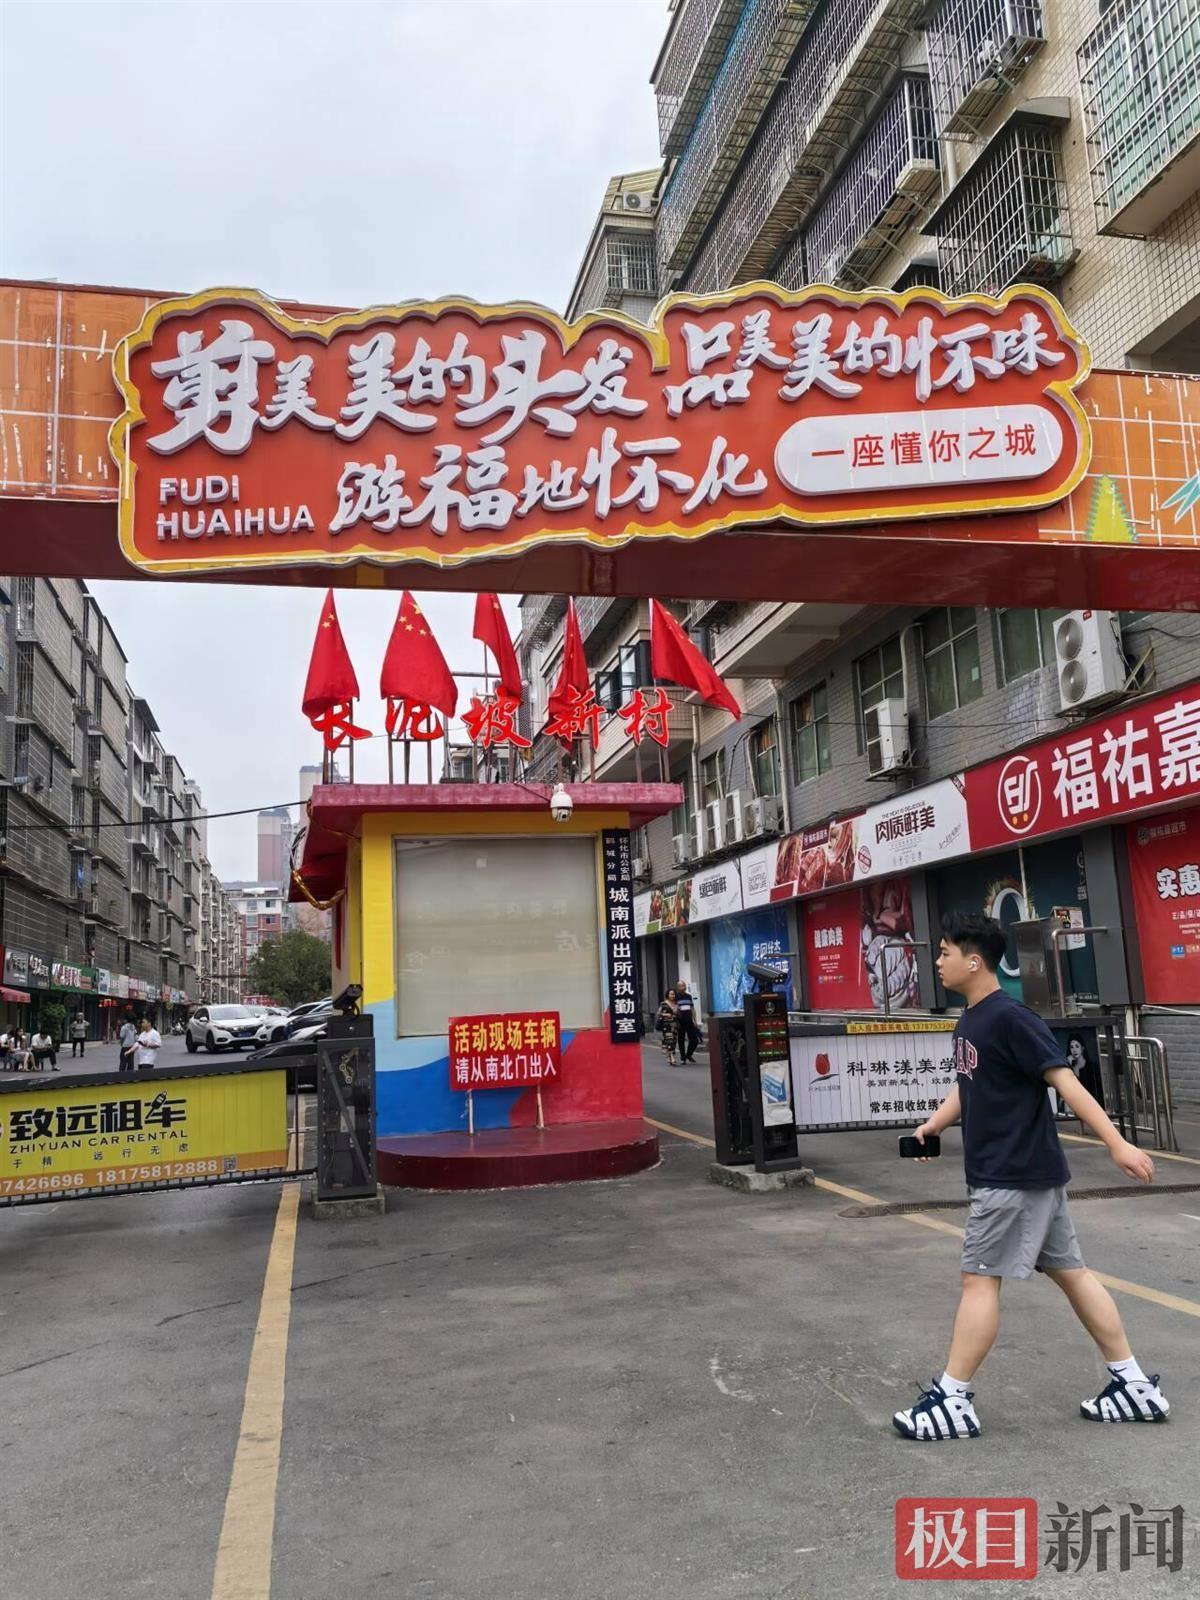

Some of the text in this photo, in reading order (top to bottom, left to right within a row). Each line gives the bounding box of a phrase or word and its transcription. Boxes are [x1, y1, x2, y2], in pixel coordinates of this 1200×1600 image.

[146, 309, 1065, 455] 剪美美的头发 品美美的怀味
[811, 423, 1037, 468] 一座懂你之城
[159, 475, 240, 506] FUDI
[330, 428, 768, 535] 游福地怀化
[156, 504, 314, 540] HUAIHUA
[875, 805, 935, 844] 肉质鲜美
[609, 887, 636, 1034] 城南派出所执勤室
[454, 1018, 556, 1053] 活动现场车辆
[456, 1053, 557, 1083] 请从南北门出入
[953, 1036, 978, 1081] AP
[9, 1096, 187, 1142] 致远租车
[9, 1129, 188, 1154] ZHIYUAN CAR RENTAL
[0, 1160, 217, 1194] 7426696 18175812888
